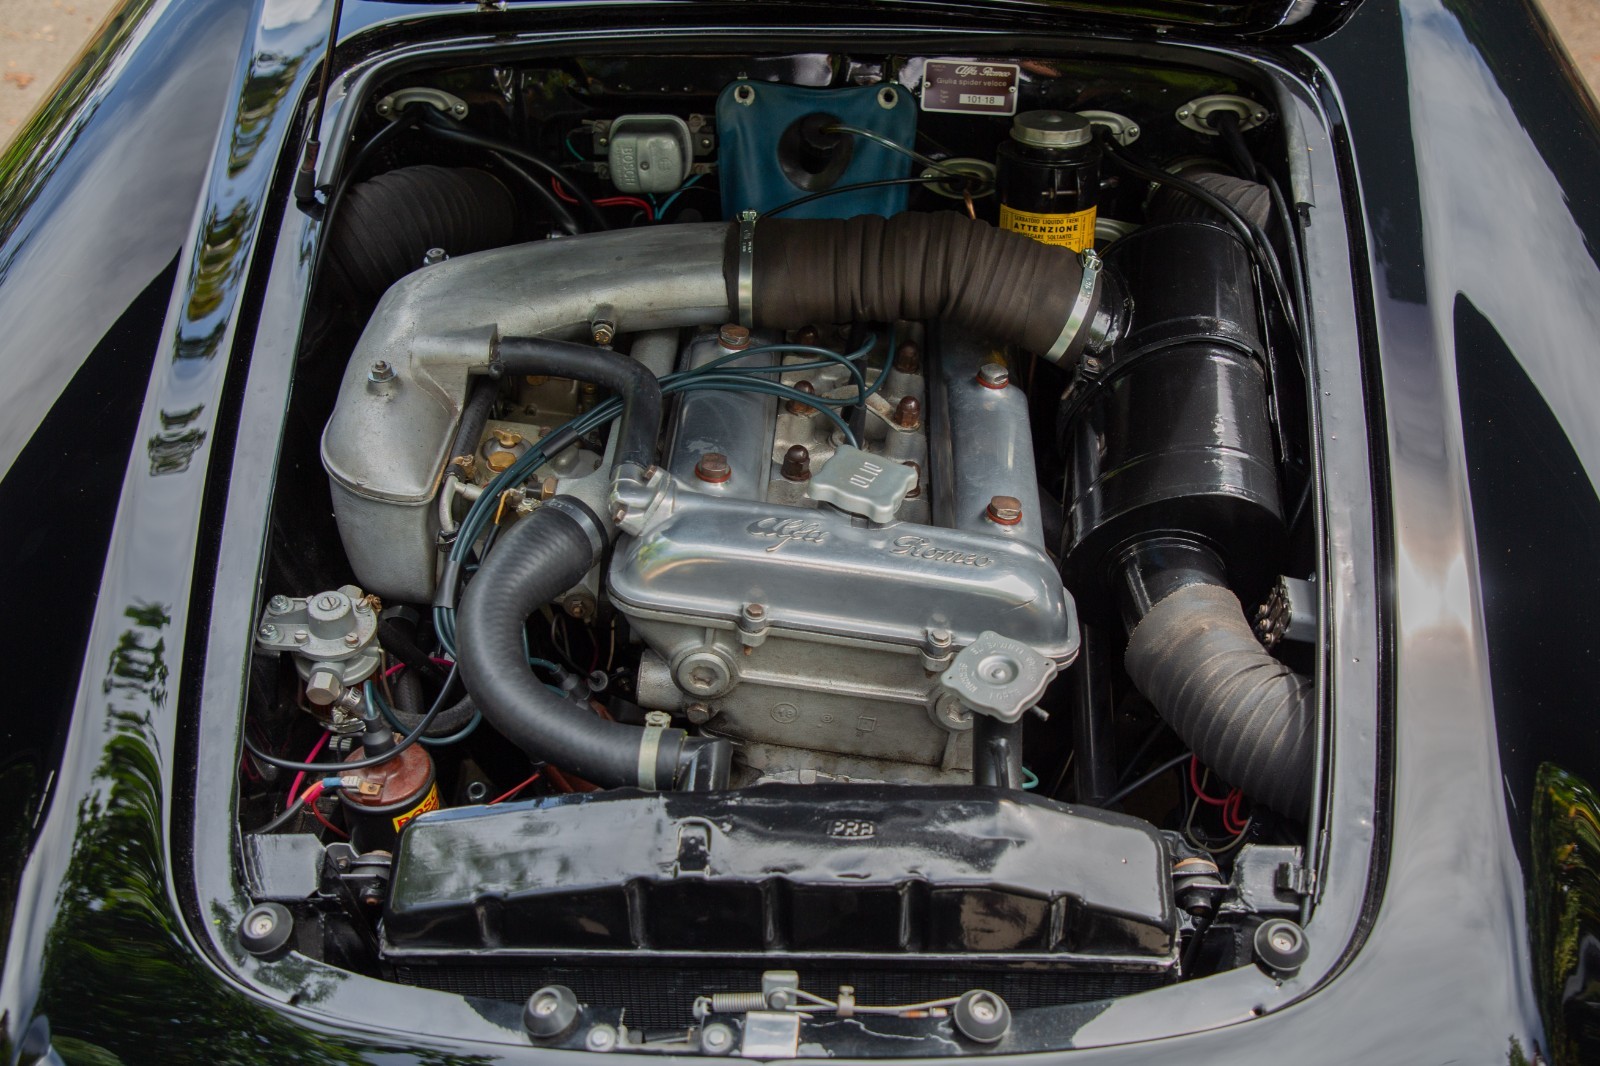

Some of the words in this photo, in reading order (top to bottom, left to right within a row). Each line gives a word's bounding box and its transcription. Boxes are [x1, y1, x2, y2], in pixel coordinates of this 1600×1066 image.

[955, 65, 977, 77] Alfa
[979, 66, 1011, 77] Romeo
[936, 77, 958, 85] Giulia
[958, 79, 982, 87] spider
[622, 147, 636, 185] BOSCH
[1014, 223, 1078, 233] ATTENZIONE
[849, 461, 883, 489] OLIO
[747, 517, 830, 552] Alfa
[890, 535, 995, 567] Romeo
